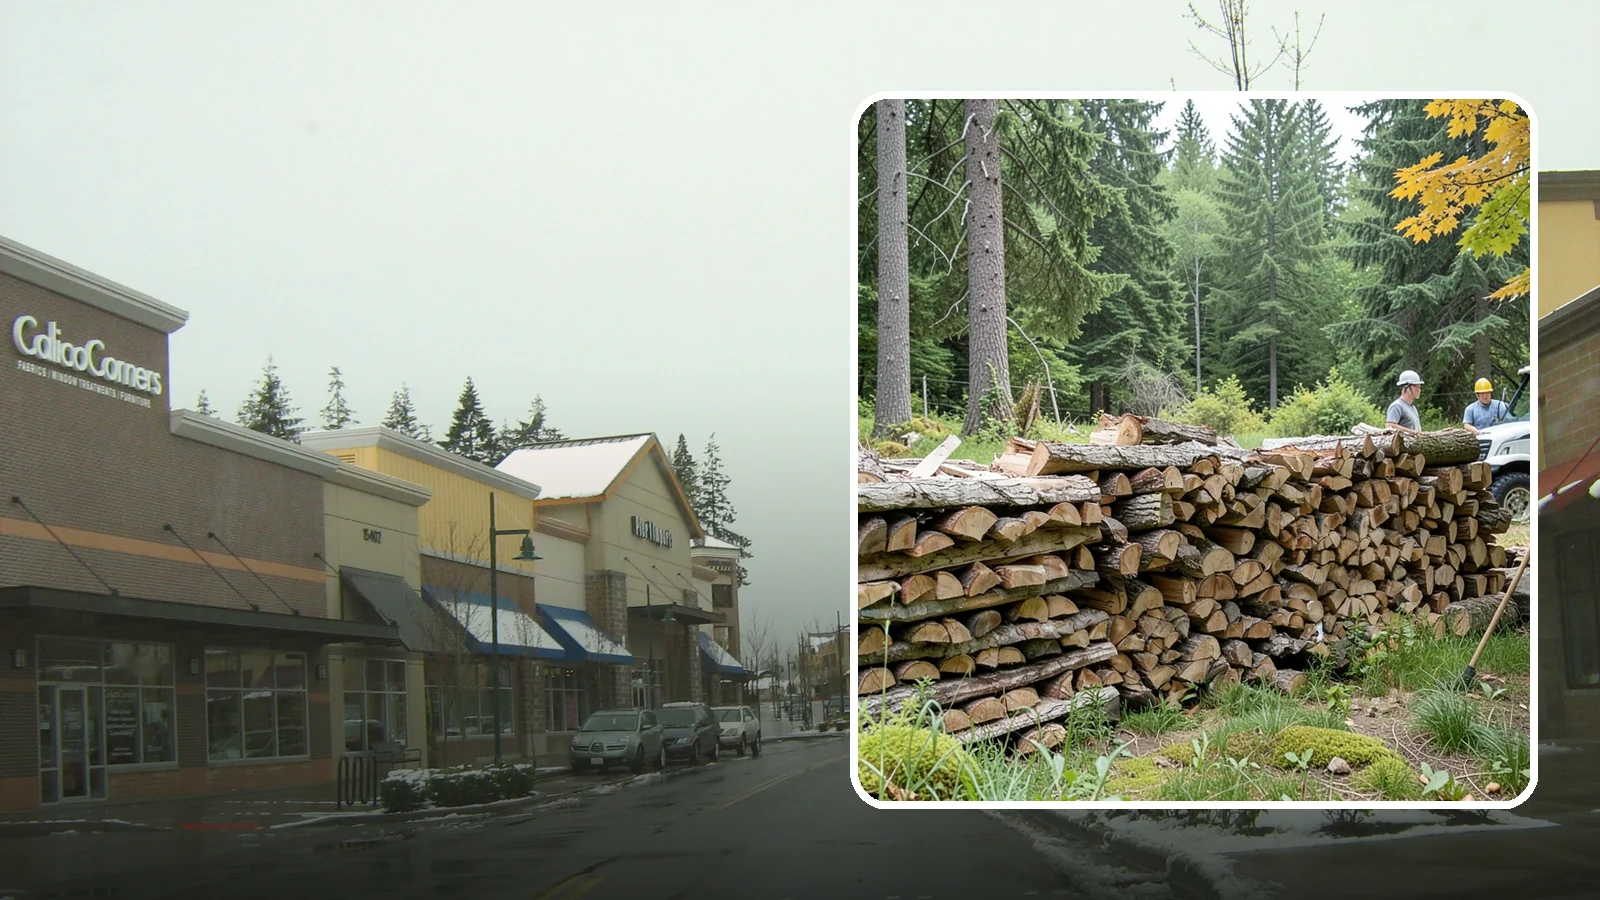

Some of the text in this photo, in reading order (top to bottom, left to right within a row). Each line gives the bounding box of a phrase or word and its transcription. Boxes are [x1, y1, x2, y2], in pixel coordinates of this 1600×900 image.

[17, 360, 151, 409] FABRICS WINDOW TREATMENTS FURNITURE
